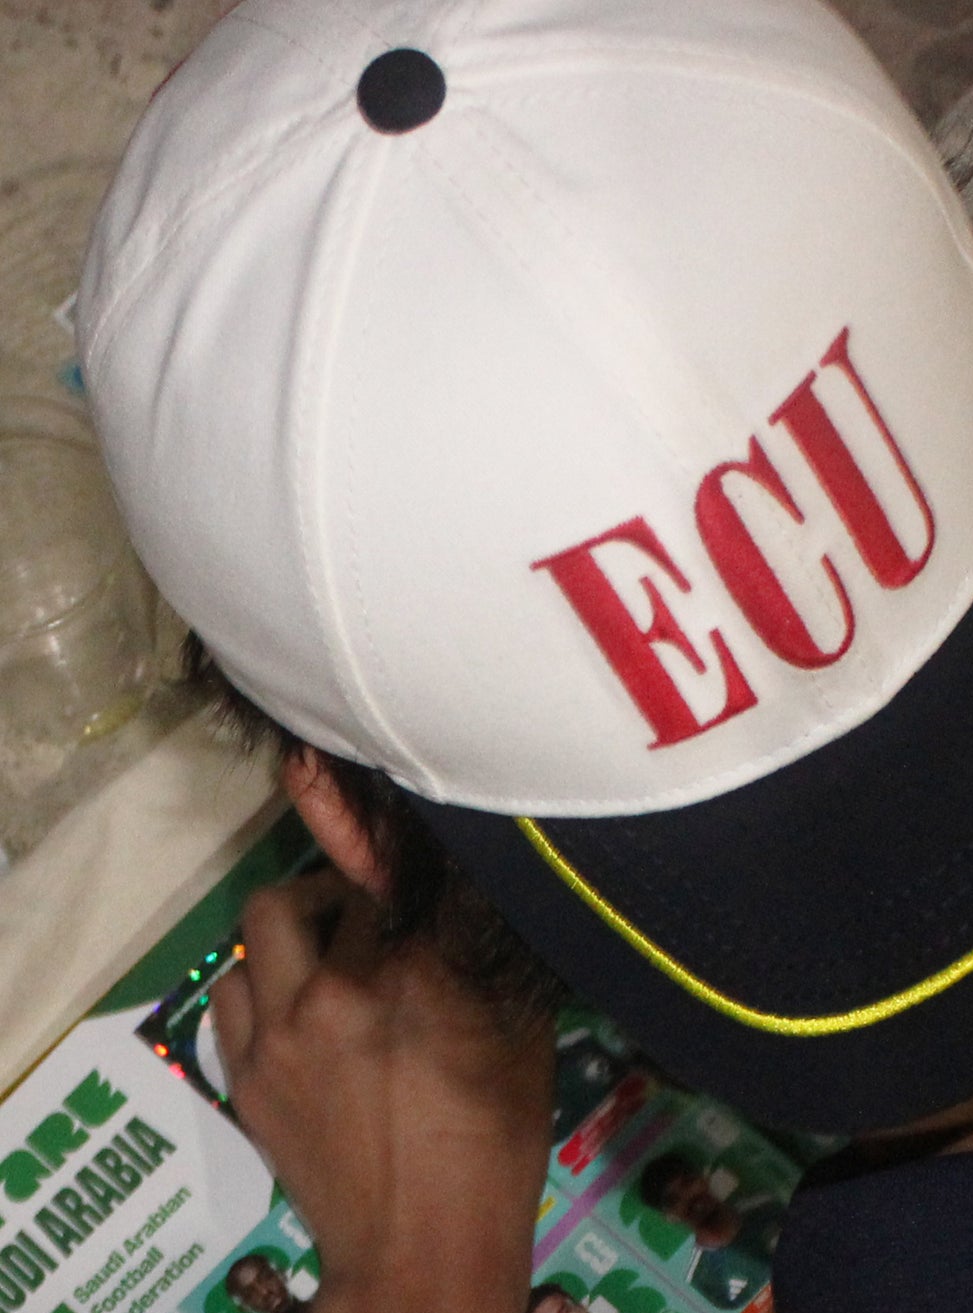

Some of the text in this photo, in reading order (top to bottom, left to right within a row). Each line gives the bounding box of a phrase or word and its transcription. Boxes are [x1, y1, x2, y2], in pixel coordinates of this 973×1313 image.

[530, 326, 935, 750] ECU
[33, 1115, 177, 1256] ARABIA
[72, 1186, 193, 1304] Saudi Arabian
